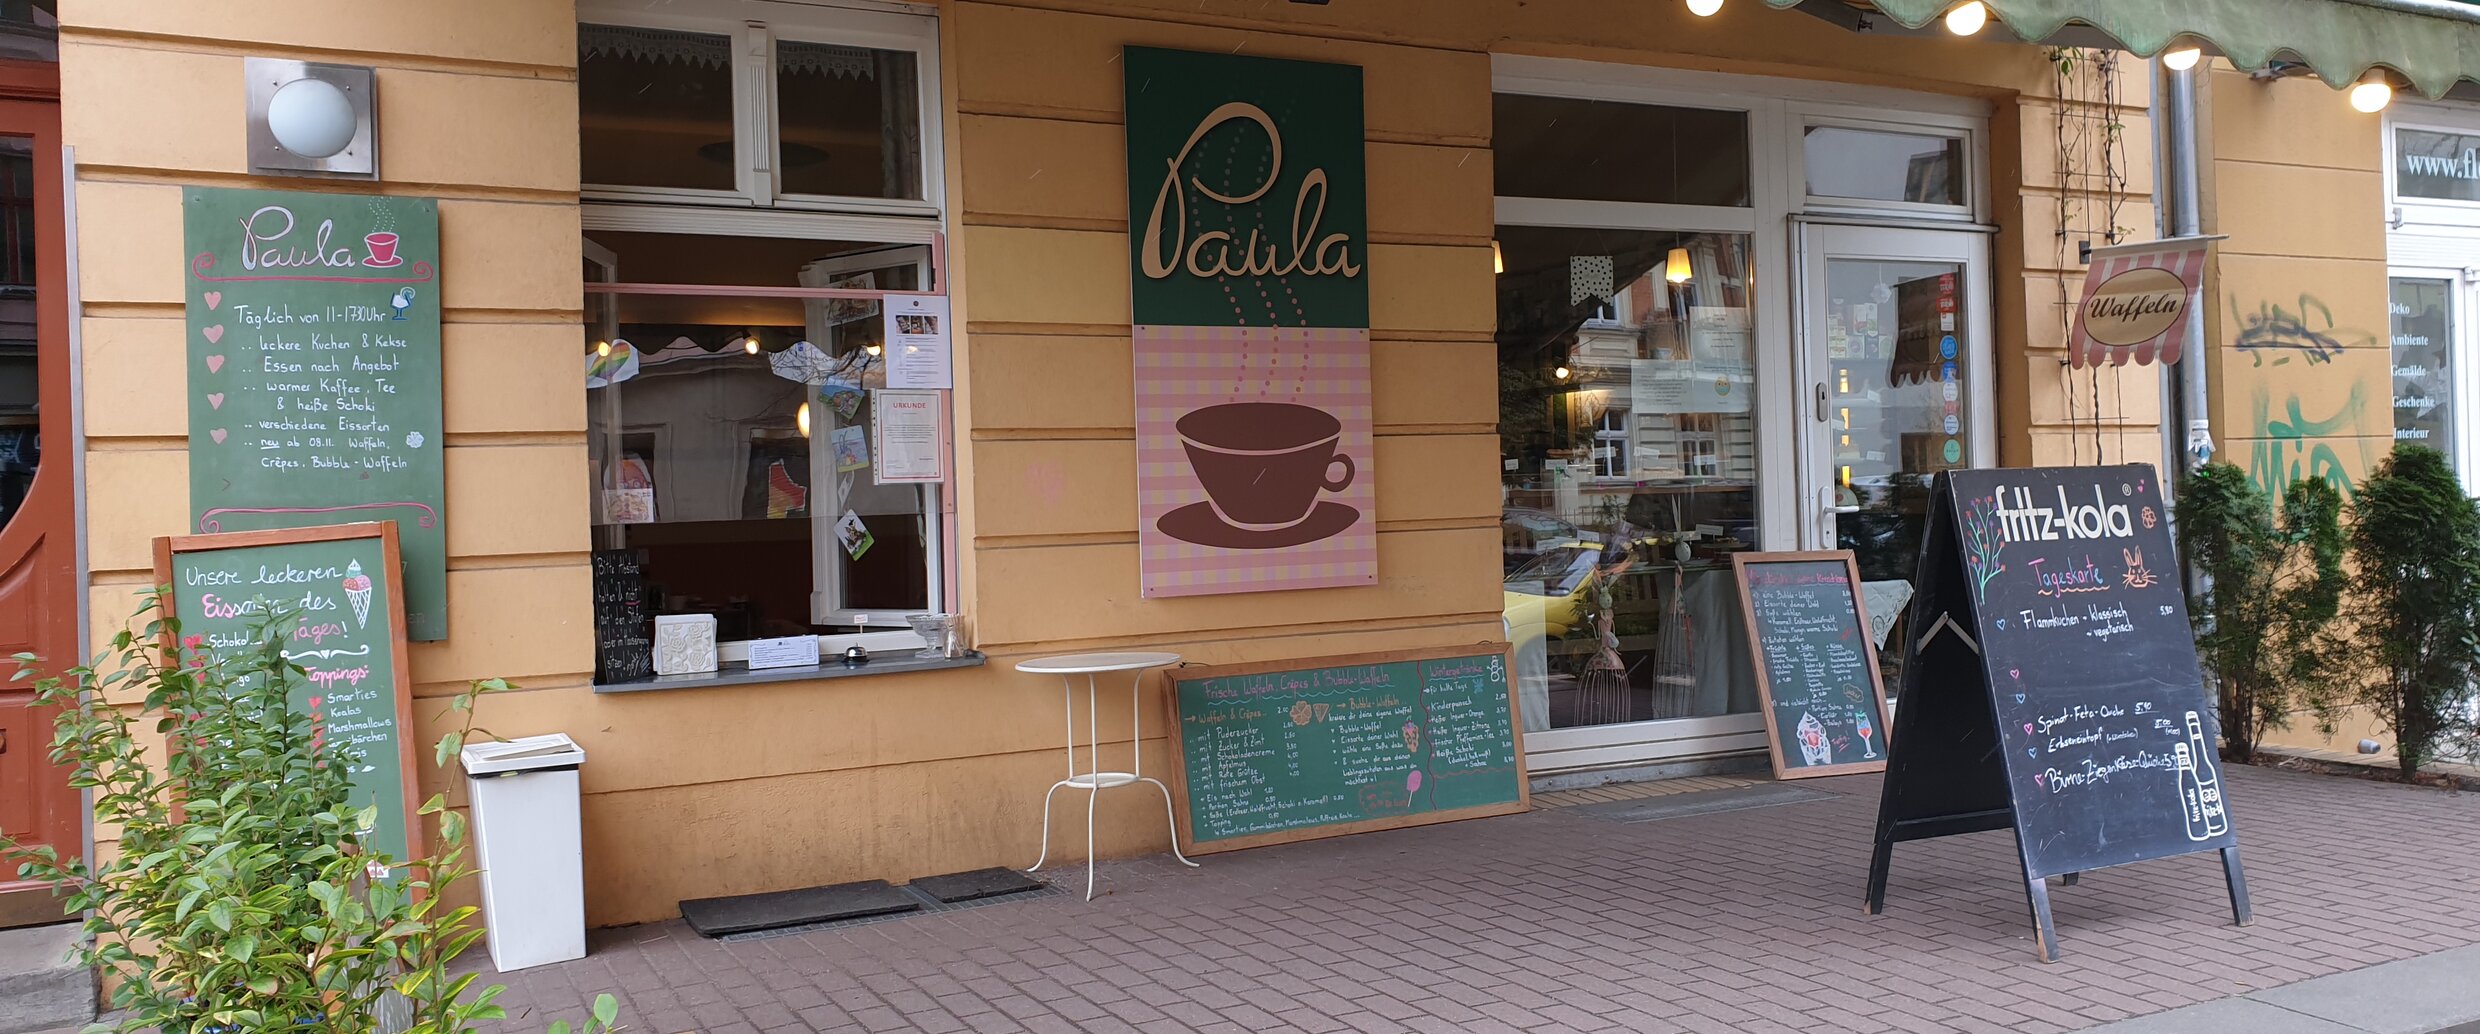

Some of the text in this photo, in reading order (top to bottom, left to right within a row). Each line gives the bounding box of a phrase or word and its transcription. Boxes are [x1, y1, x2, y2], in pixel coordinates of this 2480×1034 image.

[2406, 148, 2480, 179] www.fl
[1141, 101, 1361, 279] Paula
[239, 205, 356, 271] Paula
[233, 304, 293, 329] Täglich
[299, 310, 320, 324] von
[2090, 293, 2177, 323] Waffeln
[2389, 303, 2410, 314] Deko
[259, 333, 407, 351] leckere Kuchen & Kekse
[2391, 334, 2429, 346] Ambiente
[264, 353, 400, 374] Essen nach Angebot
[2392, 365, 2427, 376] Gemälde
[266, 383, 310, 392] warmer
[375, 378, 396, 394] Tee
[277, 397, 375, 412] & heiße Schoki
[2393, 395, 2435, 408] Geschenke
[259, 415, 390, 432] verschiedene Eissorten
[2393, 427, 2430, 439] Interieur
[260, 439, 280, 449] neu
[287, 436, 300, 447] ab
[1996, 484, 2134, 542] fritz-kola
[186, 563, 343, 586] Unsere leckeren
[597, 557, 615, 575] Bitte
[2028, 554, 2104, 598] Tageskarte
[299, 590, 337, 611] des
[2020, 603, 2080, 630] Flammkuchen
[2088, 601, 2128, 622] klassisch
[2093, 618, 2134, 642] vegetarisch
[327, 687, 378, 704] Smarties
[1203, 679, 1238, 698] Frische
[1454, 681, 1468, 692] Tage
[327, 716, 392, 734] Marshmallows
[1198, 722, 1259, 741] mit Puderzucker
[328, 730, 388, 747] bärchen
[1200, 733, 1264, 753] mit Zucker & Zimt
[1201, 748, 1276, 763] mit Schokoladencreme
[1202, 763, 1211, 773] mit
[1219, 760, 1247, 771] Apfelmus
[1202, 773, 1212, 782] mit
[1219, 769, 1234, 779] Rote
[1203, 780, 1214, 790] mit
[1251, 773, 1265, 784] Obst
[1222, 790, 1236, 800] nach
[1239, 788, 1253, 798] Wahl
